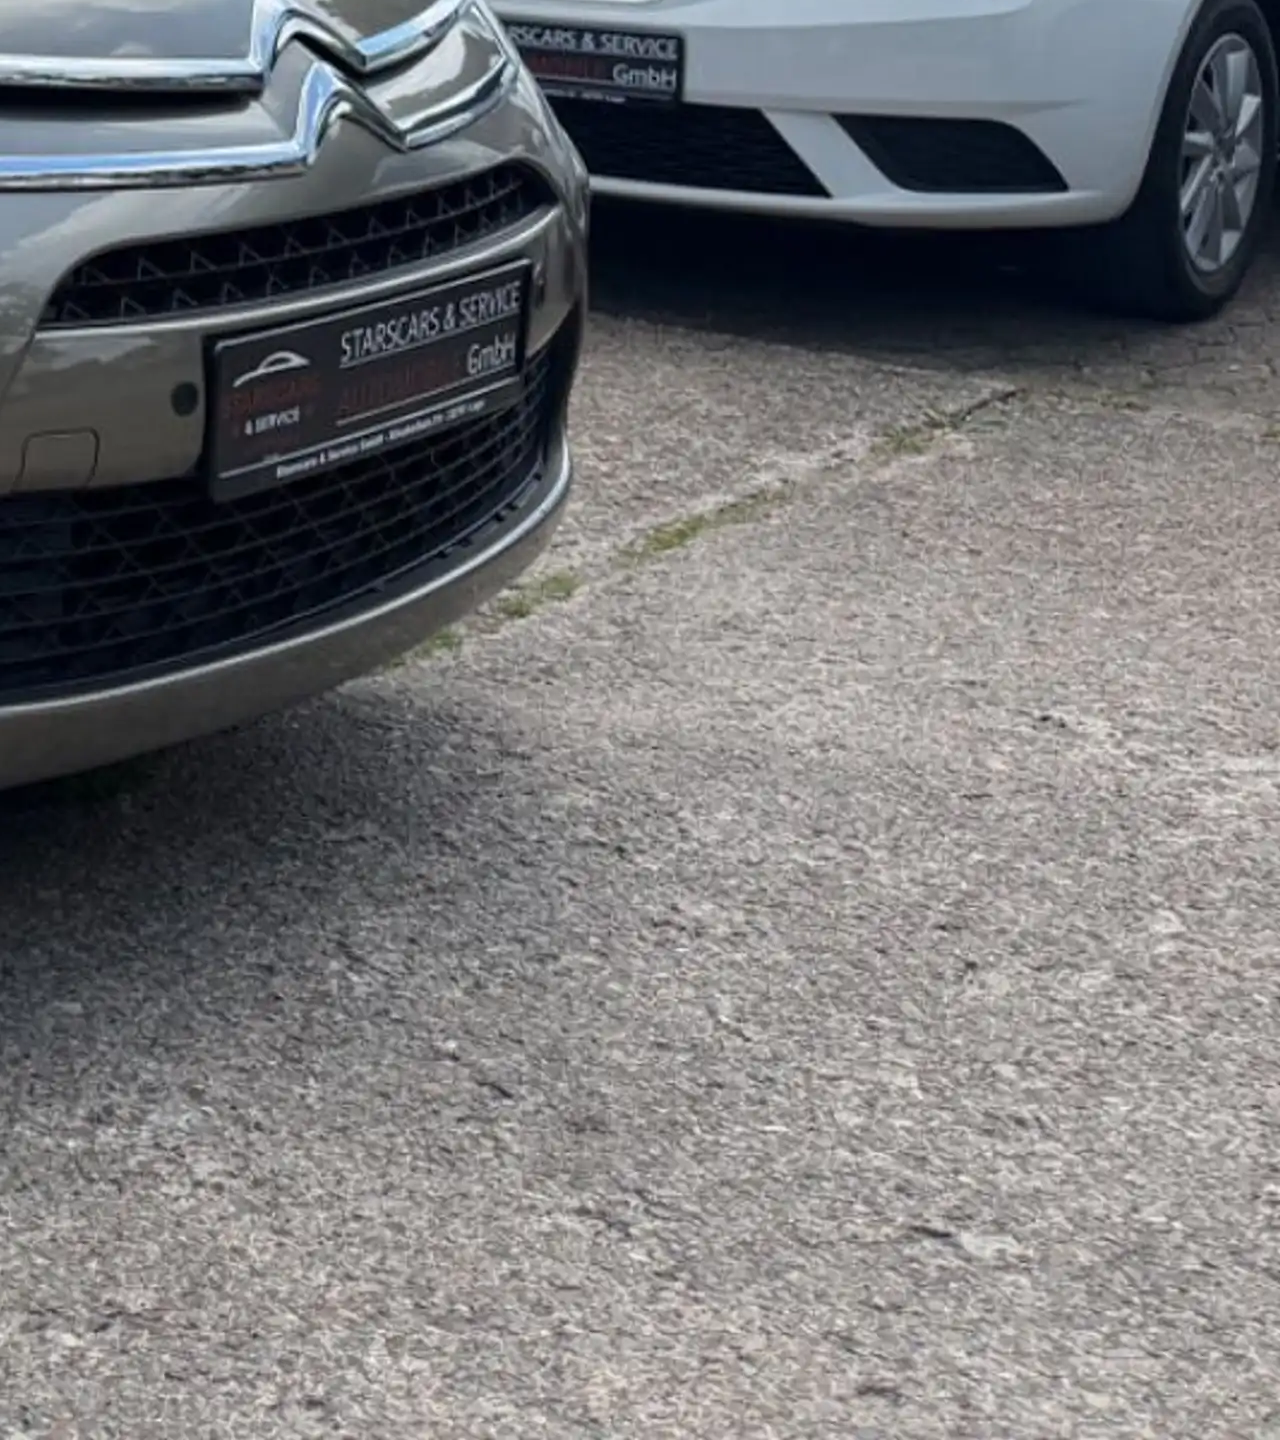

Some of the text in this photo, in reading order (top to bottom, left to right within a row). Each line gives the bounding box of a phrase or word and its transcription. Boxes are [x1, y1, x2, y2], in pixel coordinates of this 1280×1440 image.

[507, 25, 575, 50] RSCARS
[601, 34, 678, 59] SERVICE
[612, 62, 677, 89] GmbH
[341, 307, 440, 365] STARSCARS
[459, 280, 521, 328] SERVICE
[467, 332, 516, 375] GmbH
